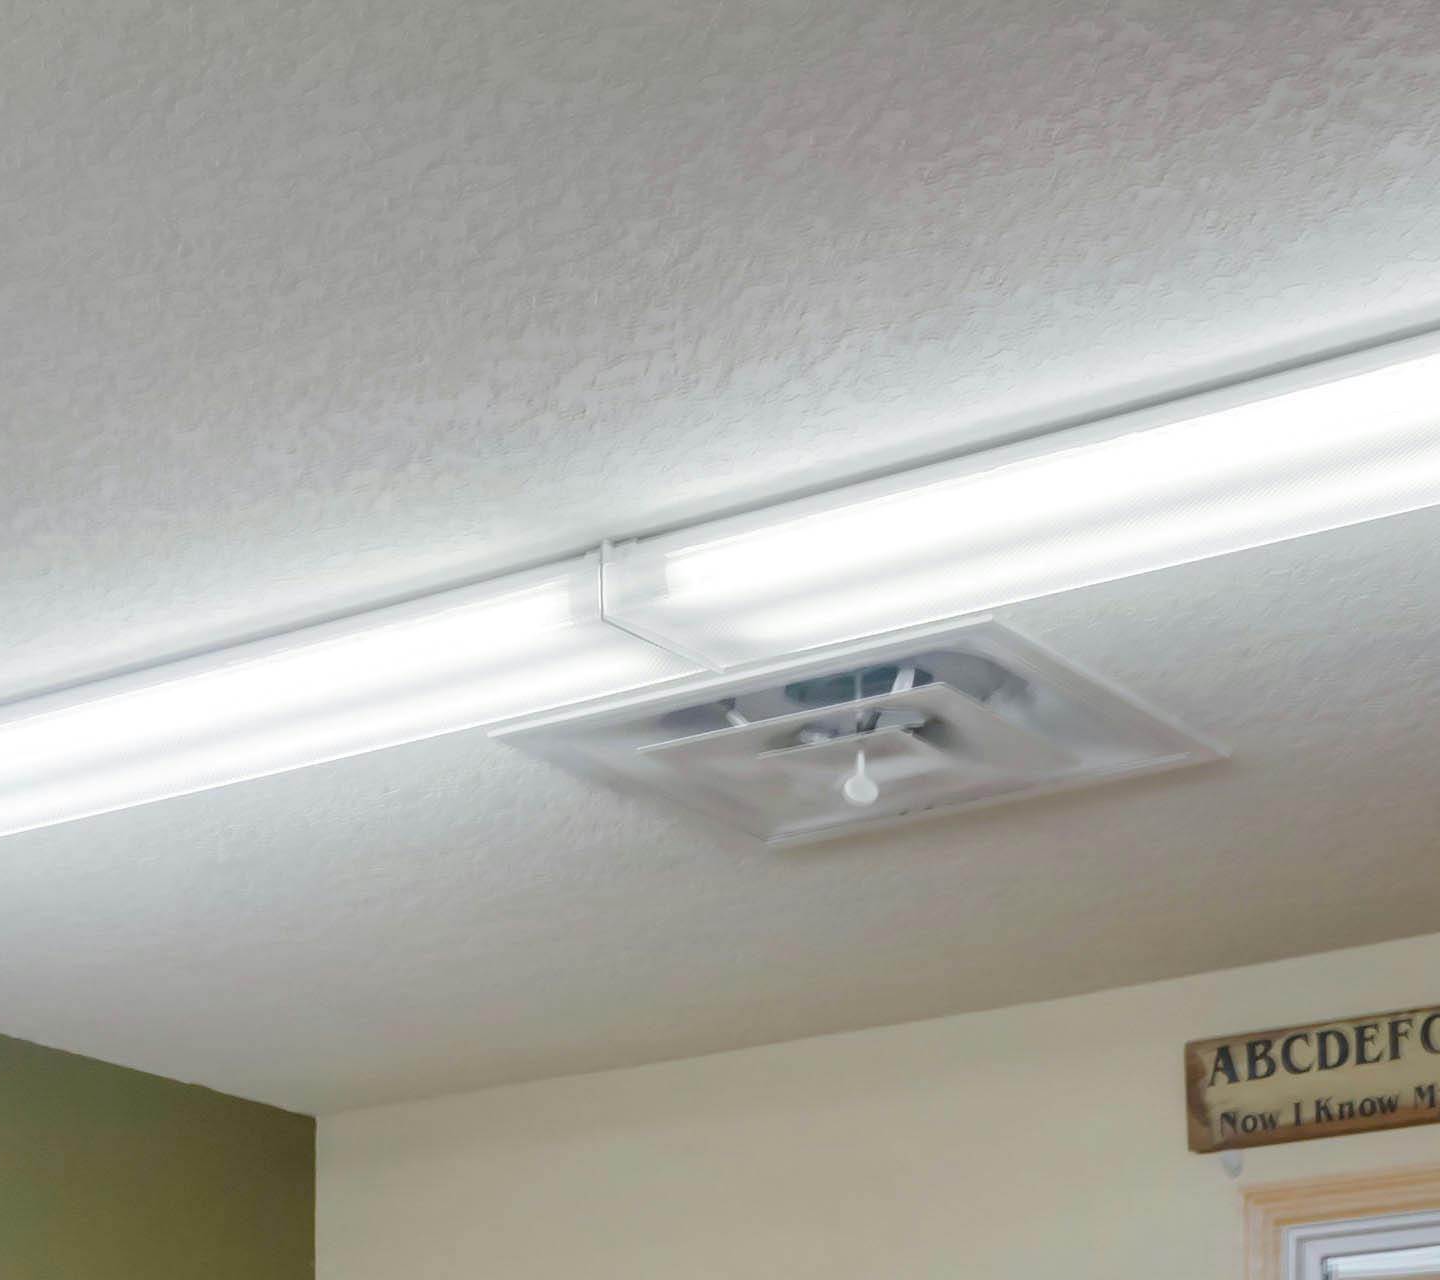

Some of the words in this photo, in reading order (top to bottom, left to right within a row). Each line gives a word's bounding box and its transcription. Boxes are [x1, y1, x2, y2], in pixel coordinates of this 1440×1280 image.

[1219, 1108, 1280, 1137] Now
[1293, 1101, 1304, 1128] I
[1313, 1094, 1400, 1124] Know
